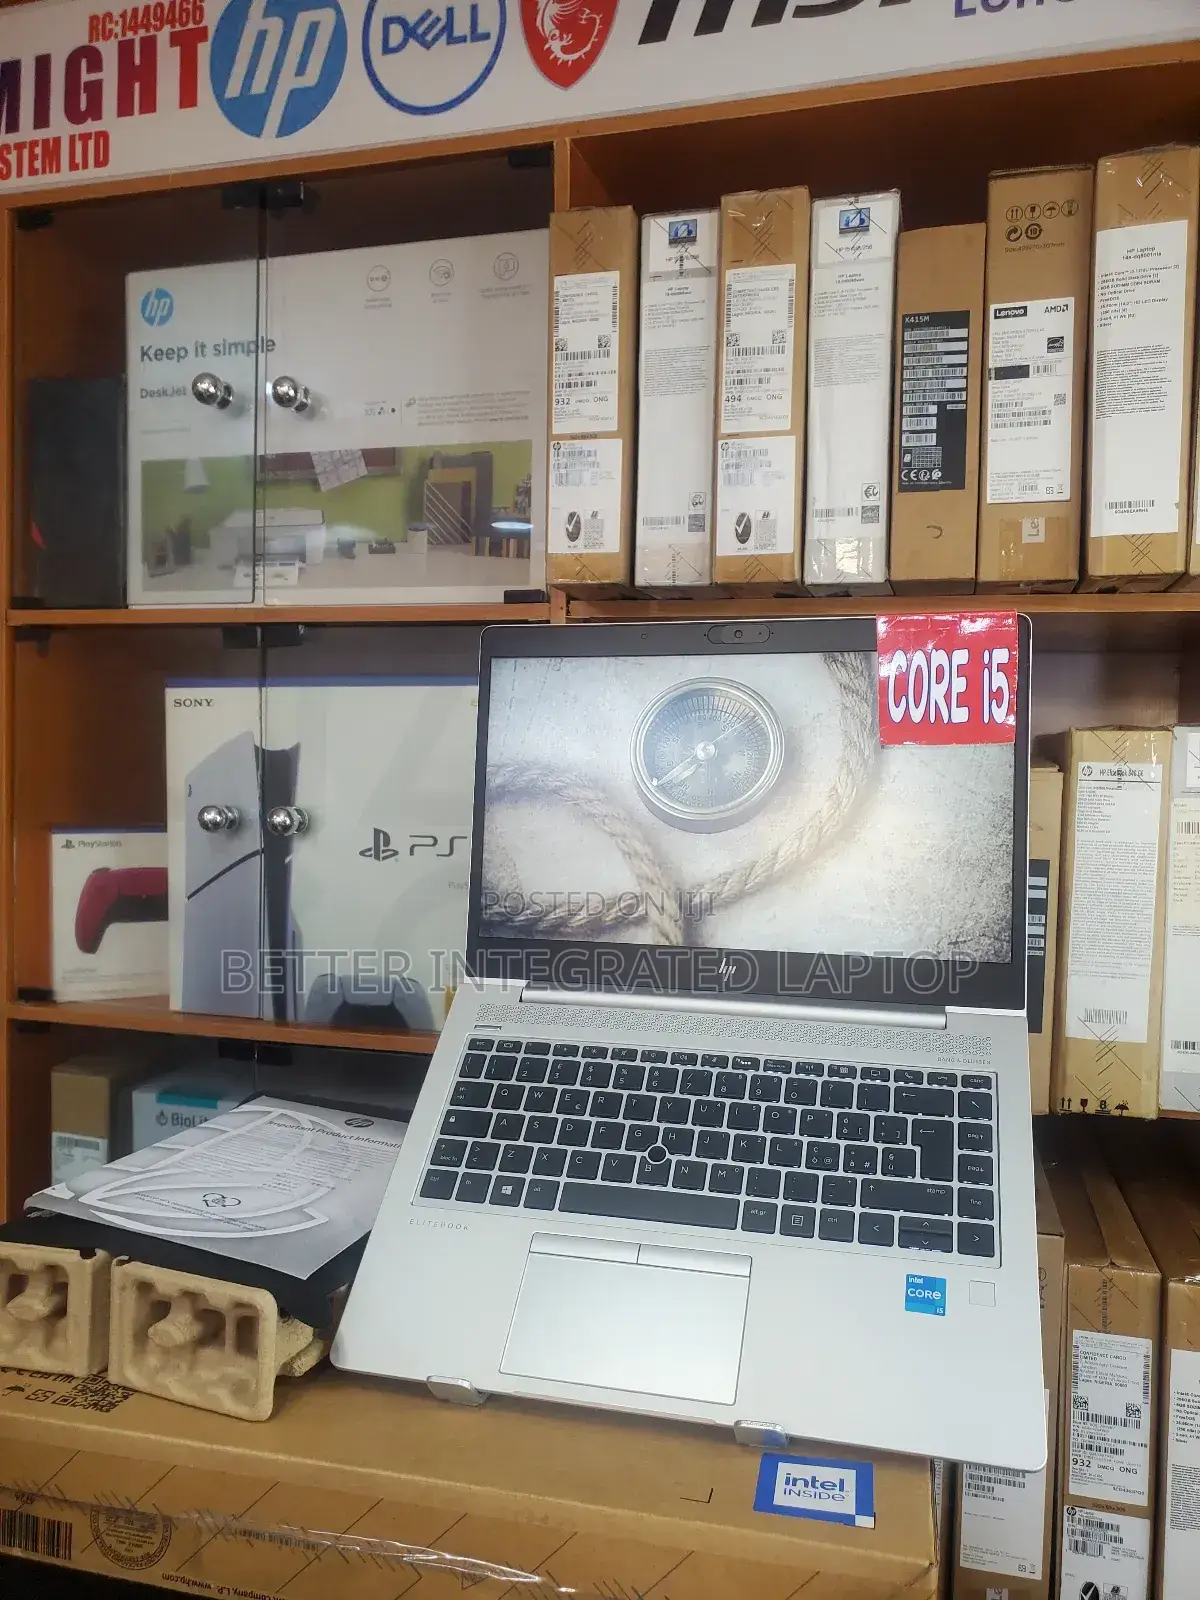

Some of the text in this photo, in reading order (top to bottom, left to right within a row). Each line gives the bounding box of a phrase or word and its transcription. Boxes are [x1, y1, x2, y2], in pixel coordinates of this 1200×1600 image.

[88, 0, 205, 43] RC:1449466
[382, 15, 491, 56] DELL
[0, 130, 110, 181] STEM LTD
[996, 305, 1062, 318] Lenovo AMD
[905, 315, 930, 323] X415M
[140, 336, 276, 363] Keep it simple
[140, 385, 187, 399] DeskJet
[555, 397, 571, 406] 932
[725, 395, 742, 403] 494
[887, 648, 1010, 724] CORE i5
[173, 698, 214, 708] SONY
[78, 839, 122, 849] PlayStation
[409, 835, 468, 857] PS
[501, 1088, 509, 1096] Q
[533, 1091, 544, 1099] W
[565, 1093, 572, 1101] E
[598, 1096, 605, 1104] R
[500, 1118, 508, 1126] A
[533, 1121, 540, 1129] S
[267, 1119, 316, 1133] Important
[316, 1127, 355, 1141] Product
[600, 1126, 606, 1134] F
[634, 1129, 642, 1137] G
[668, 1132, 676, 1140] H
[703, 1136, 710, 1144] J
[507, 1150, 515, 1158] Z
[541, 1153, 549, 1161] X
[575, 1156, 583, 1164] C
[611, 1159, 618, 1167] V
[824, 1157, 833, 1165] @
[644, 1164, 652, 1172] B
[680, 1166, 689, 1174] N
[717, 1170, 726, 1178] M
[927, 1187, 946, 1195] stamp
[970, 1198, 982, 1206] fine
[409, 1218, 470, 1231] ELITEBOOK
[908, 1276, 923, 1284] intel
[936, 1306, 944, 1314] i5
[1072, 1457, 1091, 1468] 932
[1119, 1466, 1138, 1475] ONG
[784, 1472, 845, 1492] intel
[162, 1572, 212, 1590] www.hp.com
[217, 1584, 231, 1595] L.P.
